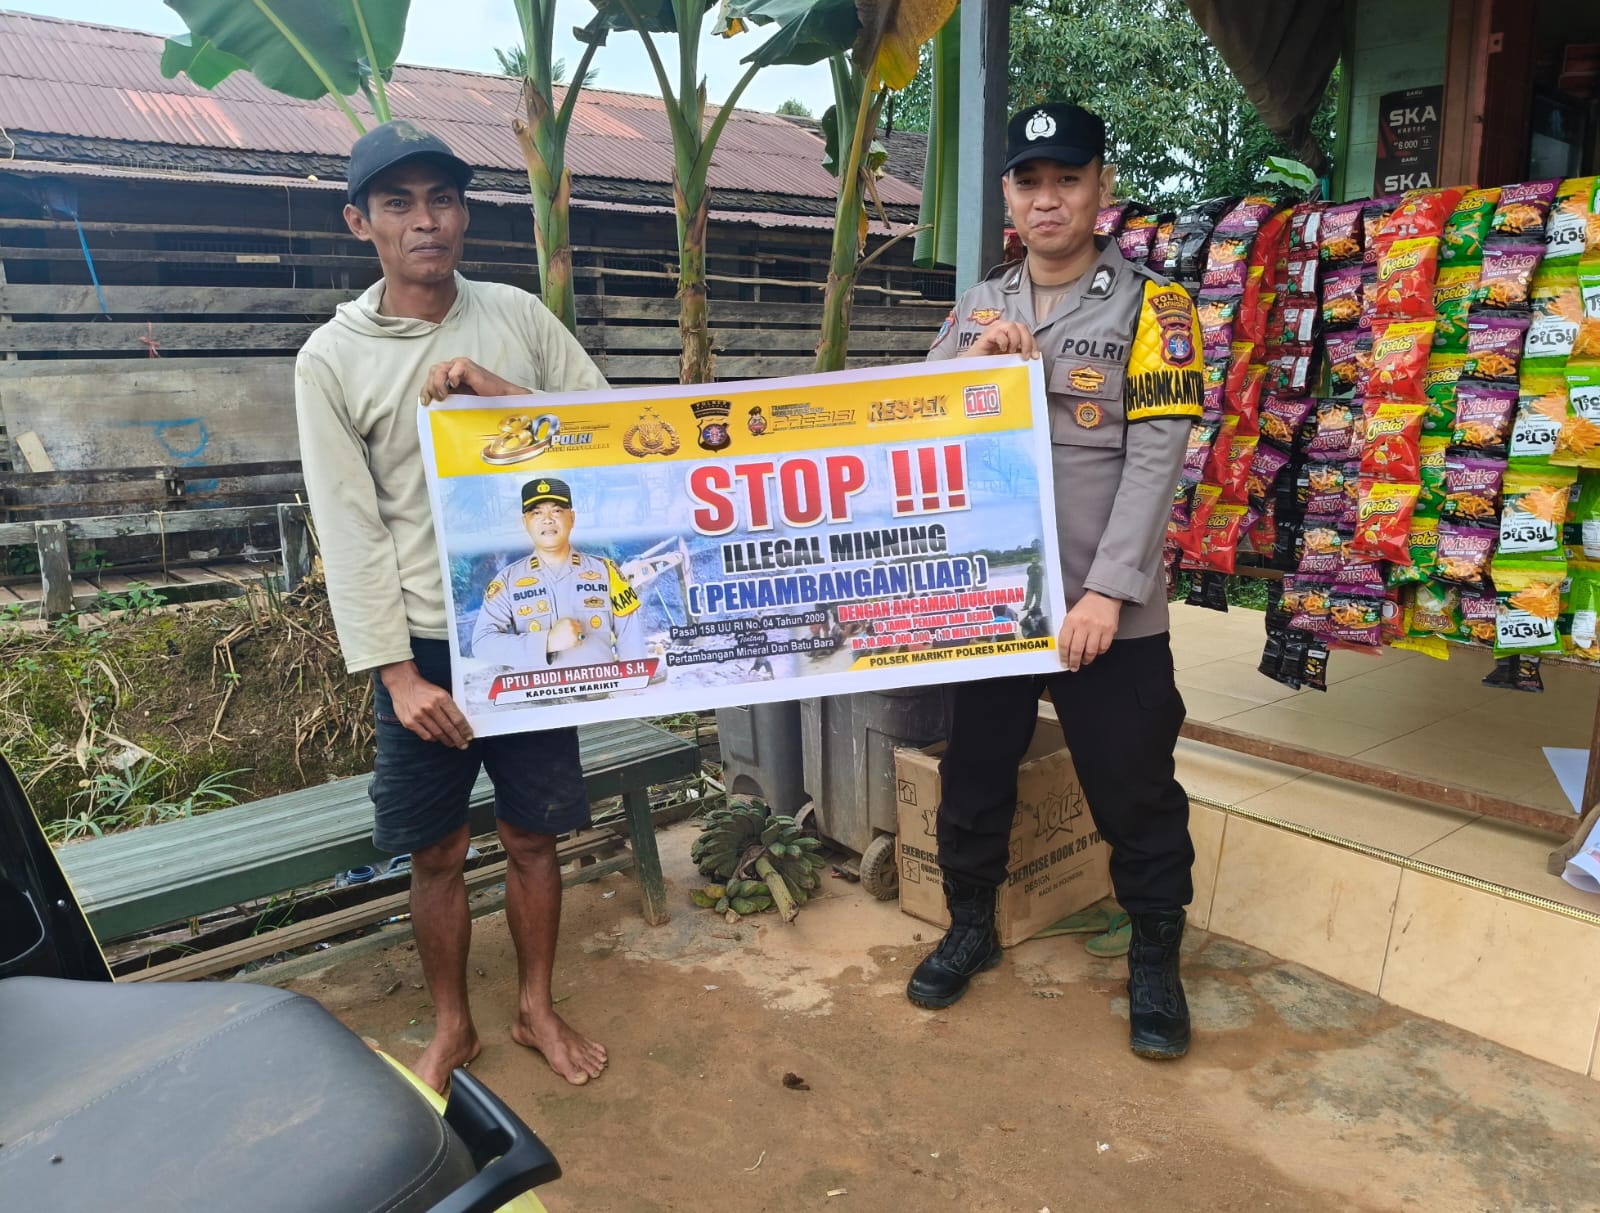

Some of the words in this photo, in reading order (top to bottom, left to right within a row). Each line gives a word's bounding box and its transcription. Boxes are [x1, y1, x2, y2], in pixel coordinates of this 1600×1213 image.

[1389, 105, 1437, 127] SKA
[1384, 172, 1432, 192] SKA
[1061, 338, 1124, 361] POLRI
[1374, 338, 1413, 361] Cheetos
[869, 395, 950, 422] RESPEK
[967, 391, 998, 411] 110
[551, 432, 593, 447] POLRI
[1367, 419, 1405, 442] Cheetos
[688, 453, 868, 533] STOP
[890, 443, 967, 514] !!!
[1360, 500, 1398, 520] Cheetos
[723, 536, 825, 573] ILLEGAL
[828, 523, 947, 562] MINNING
[576, 583, 608, 592] POLRI
[706, 565, 910, 612] PENAMBANGAN
[912, 557, 972, 591] LIAR
[838, 601, 891, 622] DENGAN
[892, 593, 958, 616] ANCAMAN
[959, 587, 1025, 608] HUKUMAN
[672, 625, 697, 638] Pasal
[700, 623, 715, 634] 158
[717, 622, 731, 632] UU
[733, 621, 743, 631] RI
[745, 619, 761, 630] No.
[762, 618, 774, 628] 04
[775, 615, 803, 627] Tahun
[804, 612, 825, 623] 2009
[873, 621, 885, 633] 10
[912, 613, 948, 629] PENJARA
[948, 613, 966, 624] DAN
[966, 609, 994, 622] DENDA
[981, 622, 1013, 636] RUPIAH
[668, 650, 734, 664] Pertambangan
[736, 647, 769, 657] Mineral
[771, 644, 788, 653] Dan
[791, 641, 812, 651] Batu
[813, 638, 834, 648] Bara
[869, 653, 909, 667] POLSEK
[911, 649, 953, 662] MARIKIT
[956, 645, 995, 657] POLRES
[997, 639, 1049, 653] KATINGAN
[501, 676, 529, 689] IPTU
[532, 673, 561, 686] BUDI
[565, 664, 623, 683] HARTONO,
[625, 662, 649, 675] S.H.
[526, 686, 577, 699] KAPOLSEK
[579, 681, 620, 692] MARIKIT
[1008, 854, 1049, 887] EXERCISE
[1049, 841, 1075, 866] BOOK
[1075, 835, 1088, 853] 26
[1024, 873, 1050, 893] DESIGN
